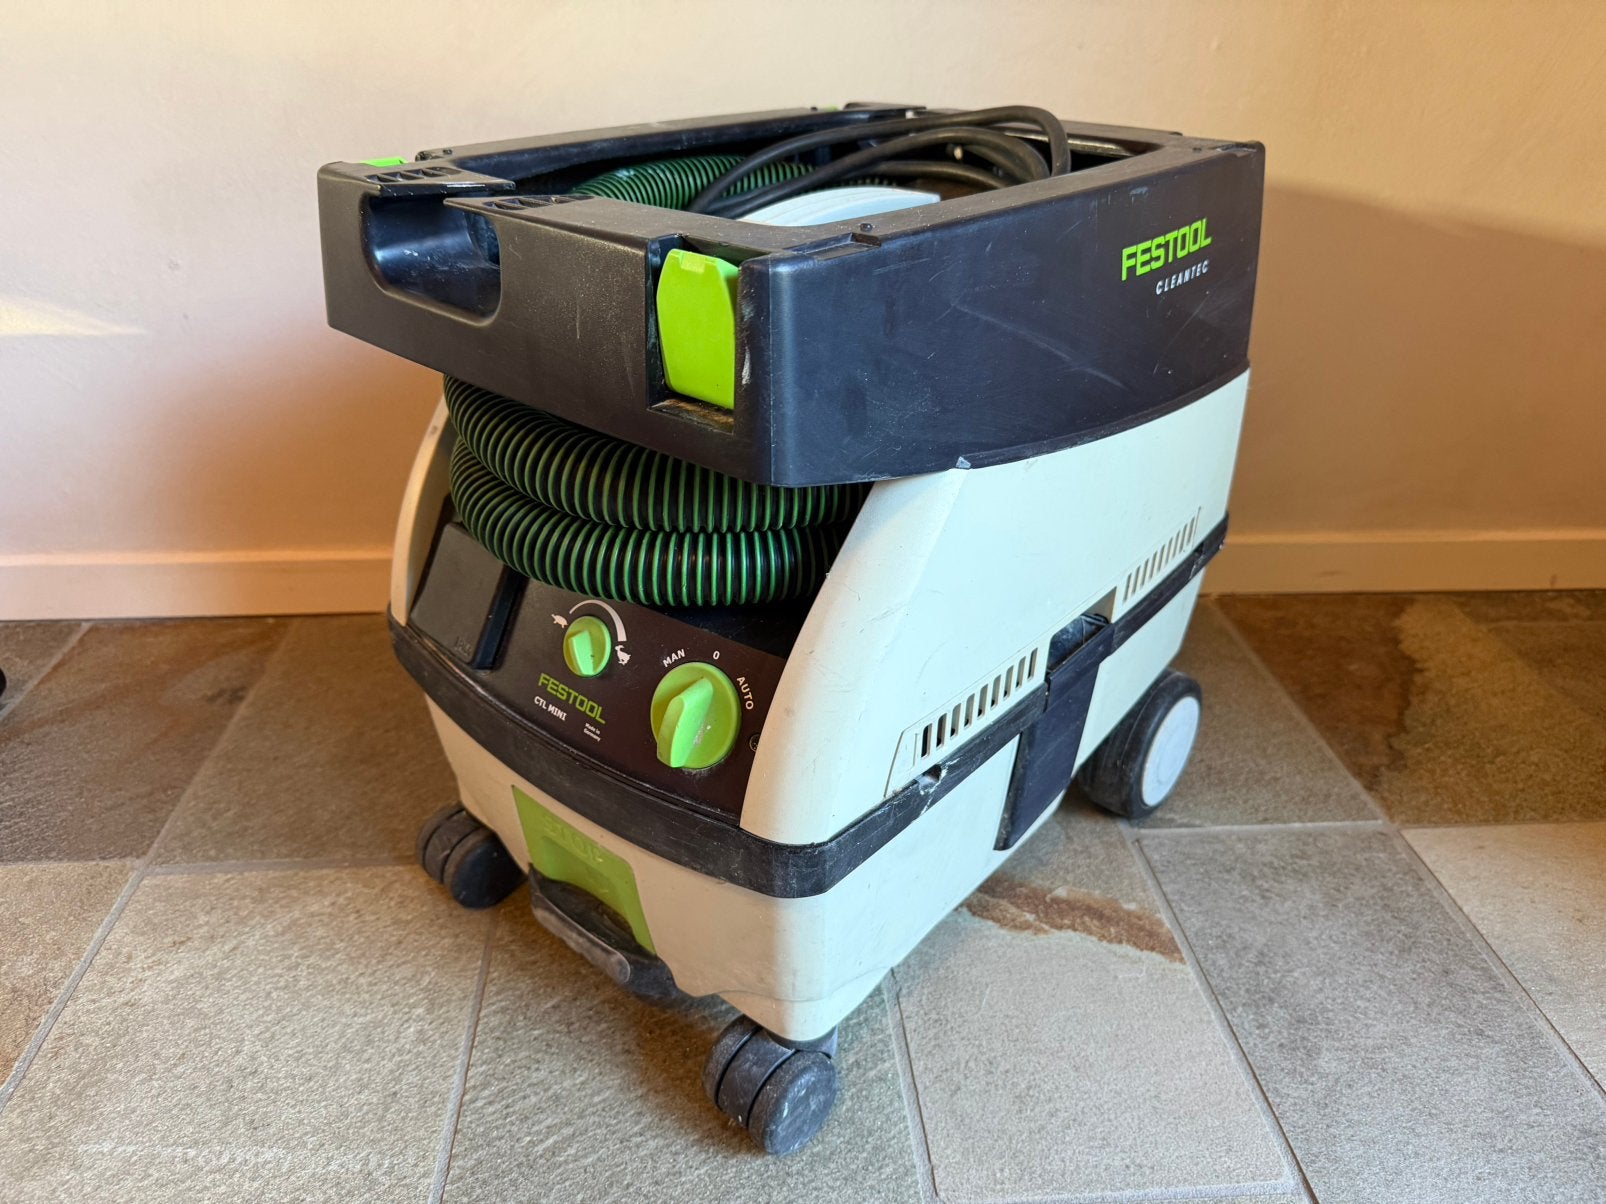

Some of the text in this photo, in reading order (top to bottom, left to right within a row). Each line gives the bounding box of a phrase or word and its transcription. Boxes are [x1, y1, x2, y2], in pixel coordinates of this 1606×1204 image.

[1121, 217, 1212, 281] FESTOOL
[1155, 259, 1209, 295] CLEANTEC
[662, 648, 686, 667] MAN
[534, 695, 568, 721] CTL MINI
[538, 672, 606, 725] FESTOOL
[736, 676, 754, 710] AUTO
[543, 814, 604, 865] STOP
